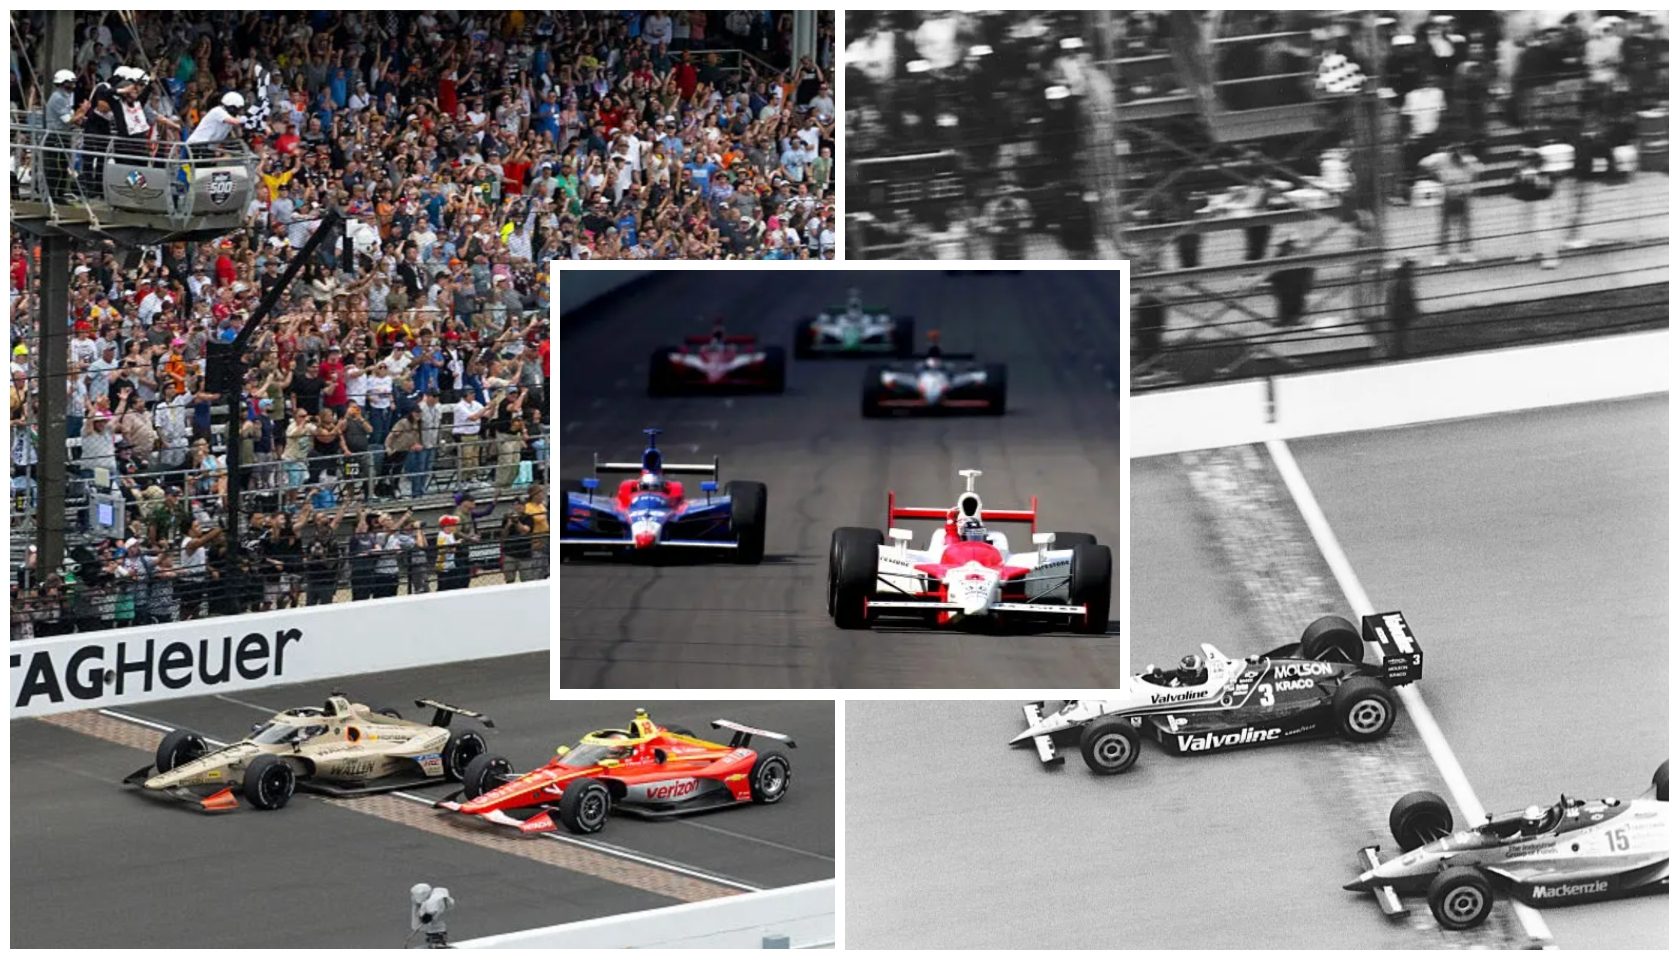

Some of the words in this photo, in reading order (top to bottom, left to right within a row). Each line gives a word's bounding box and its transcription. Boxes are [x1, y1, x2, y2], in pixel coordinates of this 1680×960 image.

[209, 181, 233, 194] 500
[1412, 654, 1421, 666] 3
[1274, 662, 1333, 679] MOLSON
[1275, 678, 1315, 692] KRACO
[1151, 690, 1208, 705] Valvoline
[1258, 683, 1275, 707] 3
[1177, 727, 1282, 752] Valvoline
[646, 779, 700, 800] verizon
[1604, 829, 1630, 852] 15
[1532, 880, 1608, 899] Mackenzie
